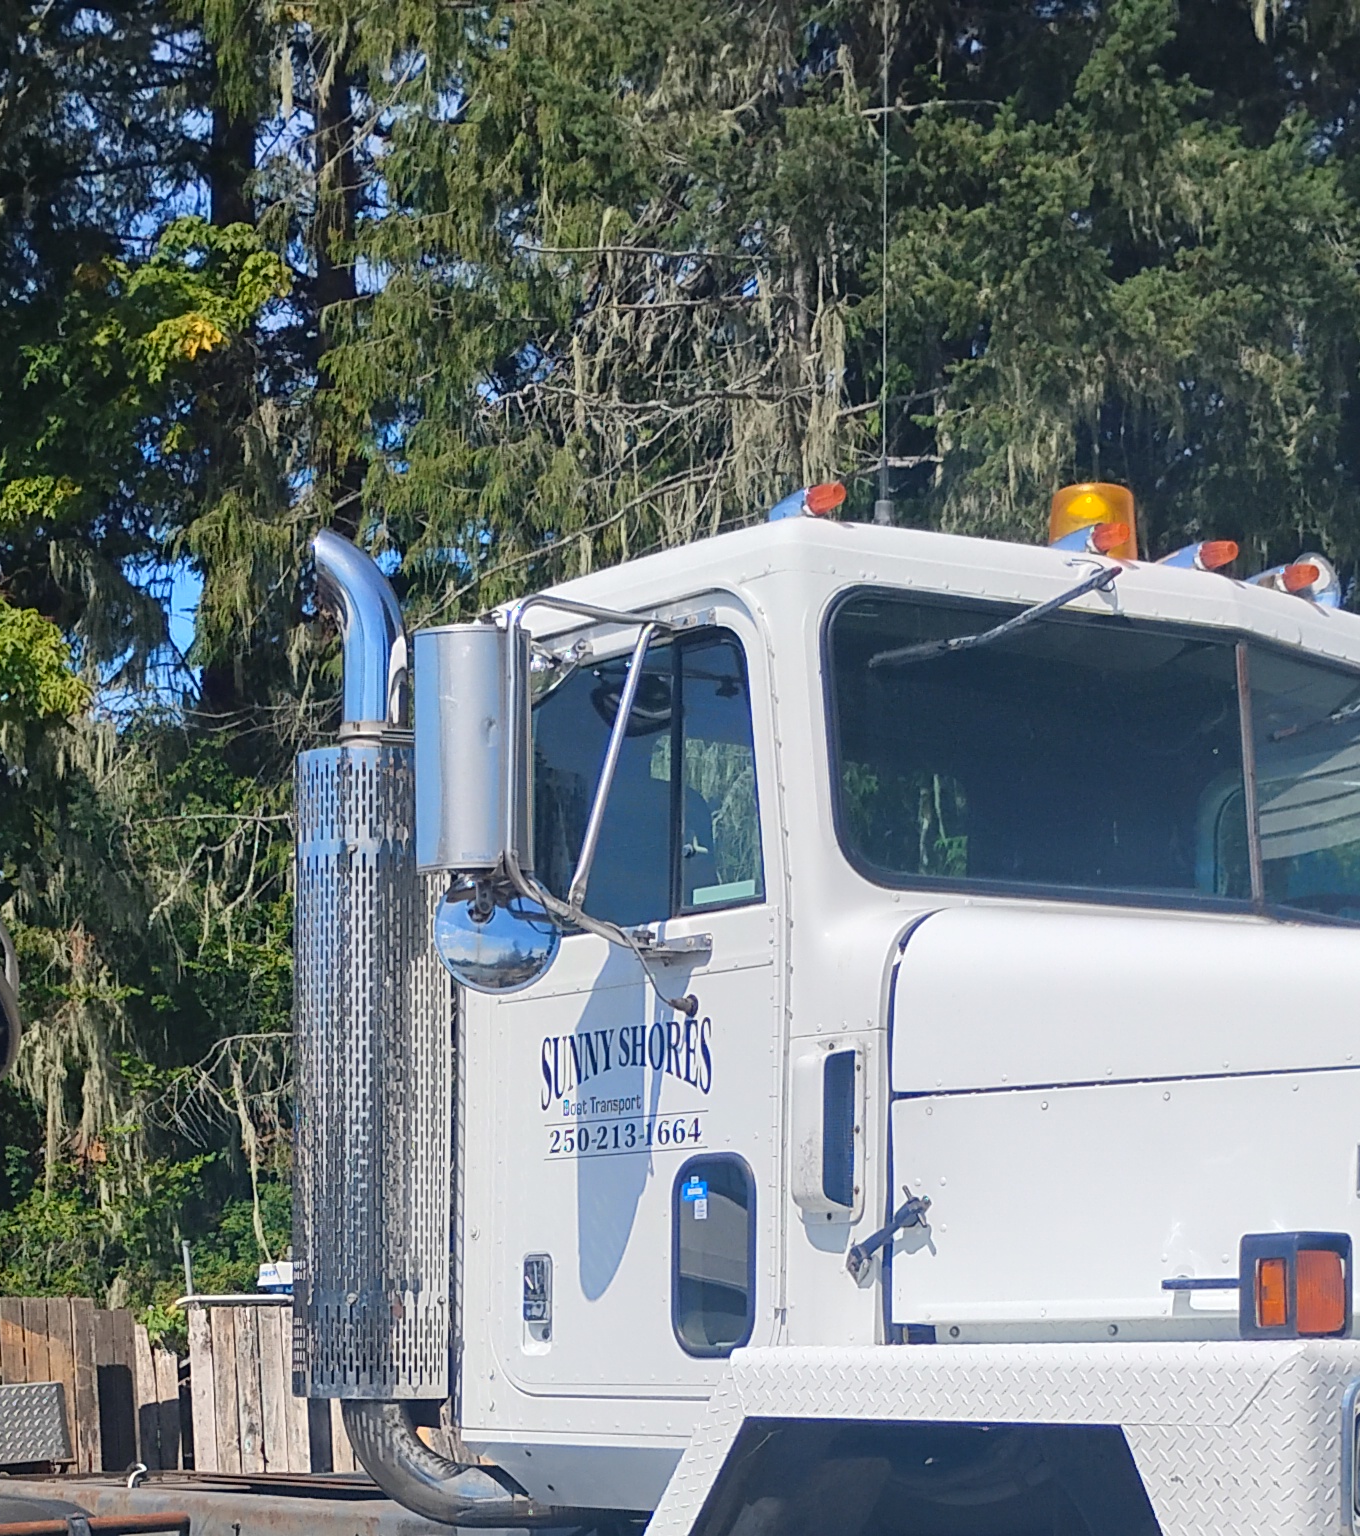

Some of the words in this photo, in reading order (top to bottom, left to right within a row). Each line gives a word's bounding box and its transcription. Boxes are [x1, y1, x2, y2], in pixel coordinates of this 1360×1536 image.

[540, 1028, 615, 1111] SUNNY
[618, 1016, 713, 1095] SHORES
[589, 1094, 642, 1116] Transport
[548, 1117, 703, 1155] 250-213-1664
